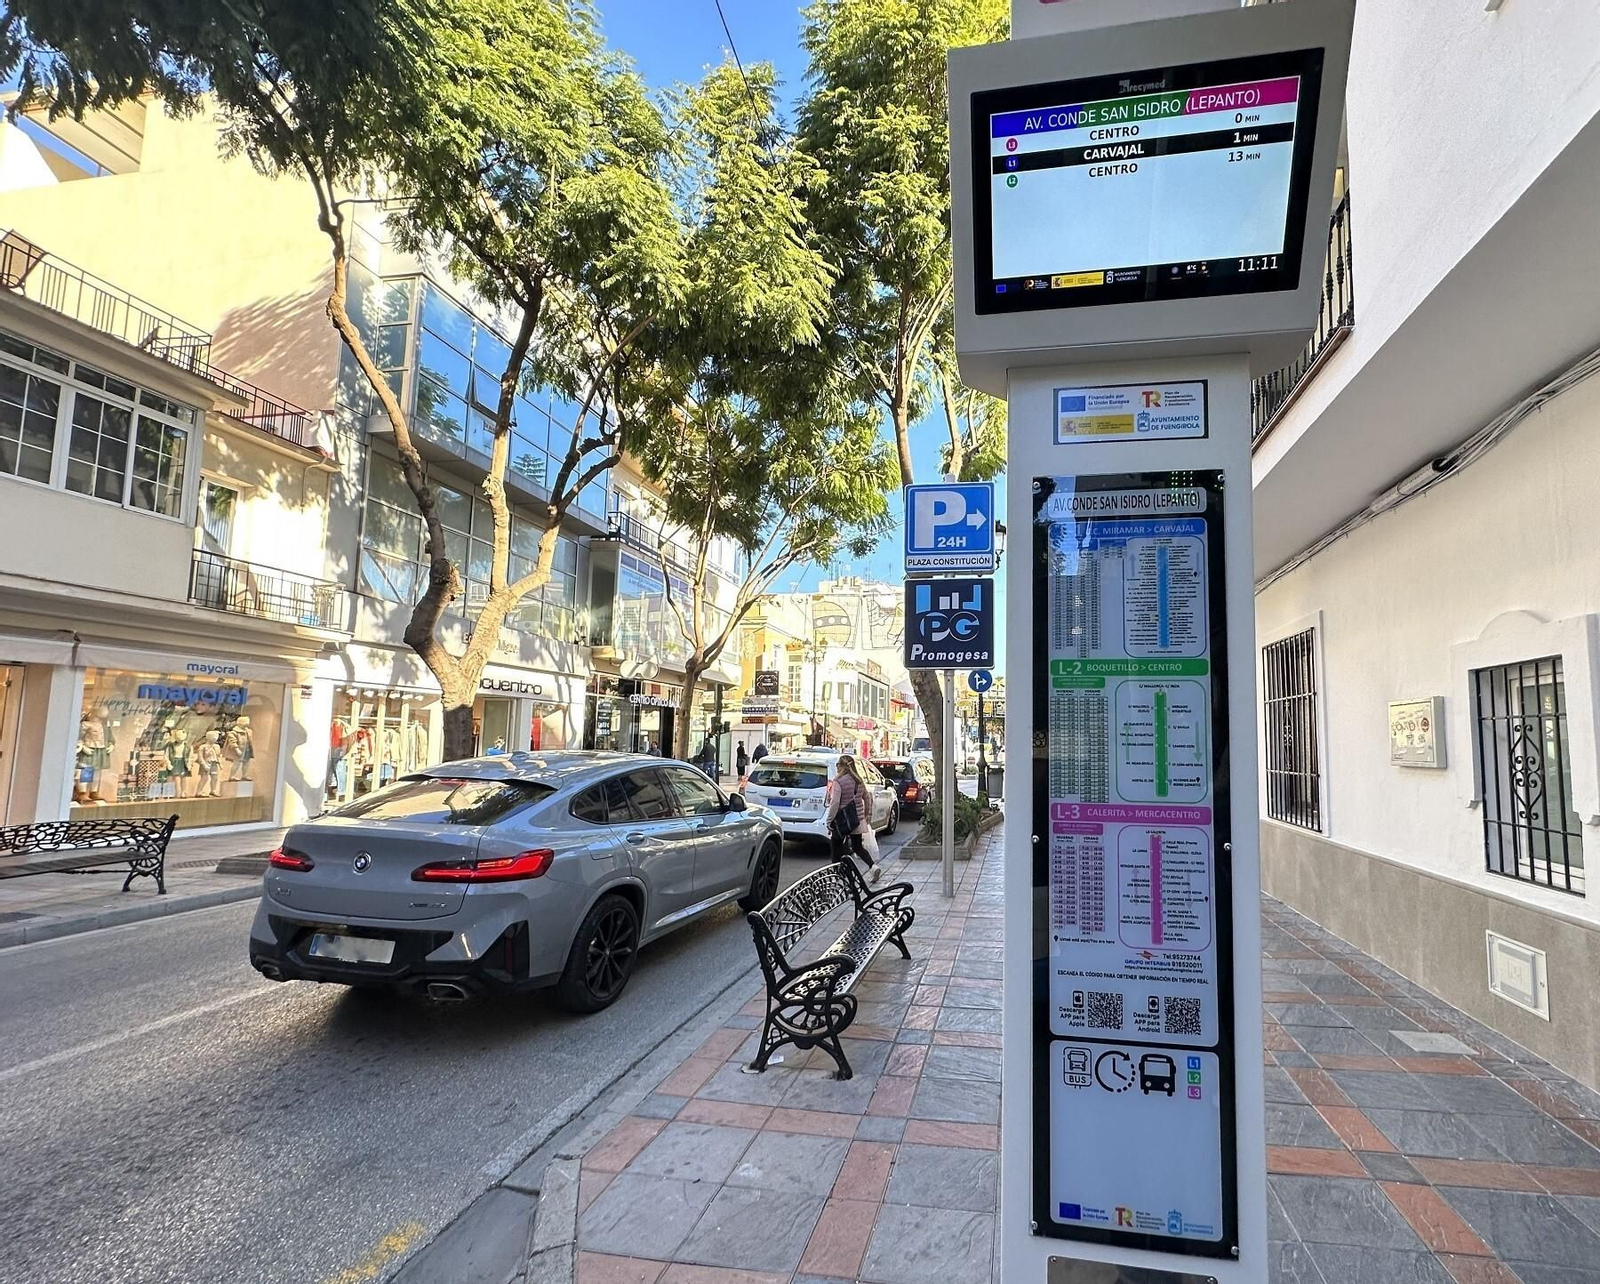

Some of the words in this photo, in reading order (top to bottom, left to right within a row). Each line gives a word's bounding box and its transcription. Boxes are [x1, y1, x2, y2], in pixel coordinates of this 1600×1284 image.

[1024, 116, 1043, 130] AV.
[1049, 109, 1096, 127] CONDE
[1101, 106, 1128, 121] SAN
[1134, 100, 1180, 118] ISIDRO
[1186, 89, 1260, 113] (LEPANTO)
[1235, 113, 1242, 124] 0
[1245, 114, 1260, 122] MIN
[1089, 125, 1140, 140] CENTRO
[1233, 132, 1241, 143] 1
[1243, 134, 1258, 142] MIN
[1084, 144, 1144, 160] CARVAJAL
[1228, 151, 1243, 162] 13
[1089, 163, 1138, 177] CENTRO
[1238, 256, 1278, 272] 11:11
[1100, 495, 1118, 509] SAN
[1120, 494, 1150, 509] ISIDRO
[1153, 491, 1200, 511] (LEPANTO)
[914, 490, 966, 548] P
[1154, 524, 1195, 532] CARVAJAL
[937, 537, 966, 548] 24H
[933, 556, 990, 565] CONSTITUCIÓN
[910, 644, 989, 662] Promogesa
[187, 662, 238, 674] mayoral
[1059, 661, 1082, 674] L-2
[1086, 663, 1139, 672] BOQUETILLO
[138, 684, 248, 706] mayoral
[1057, 804, 1081, 819] L-3
[1087, 808, 1126, 817] CALERITA
[1135, 809, 1200, 819] MERCACENTRO
[1138, 974, 1170, 982] INFORMACIÓN
[1133, 1012, 1160, 1020] Descarga
[1069, 1020, 1084, 1028] Apple
[1189, 1059, 1199, 1068] L1
[1069, 1075, 1086, 1084] BUS
[1188, 1073, 1200, 1082] L2
[1189, 1088, 1200, 1097] L3
